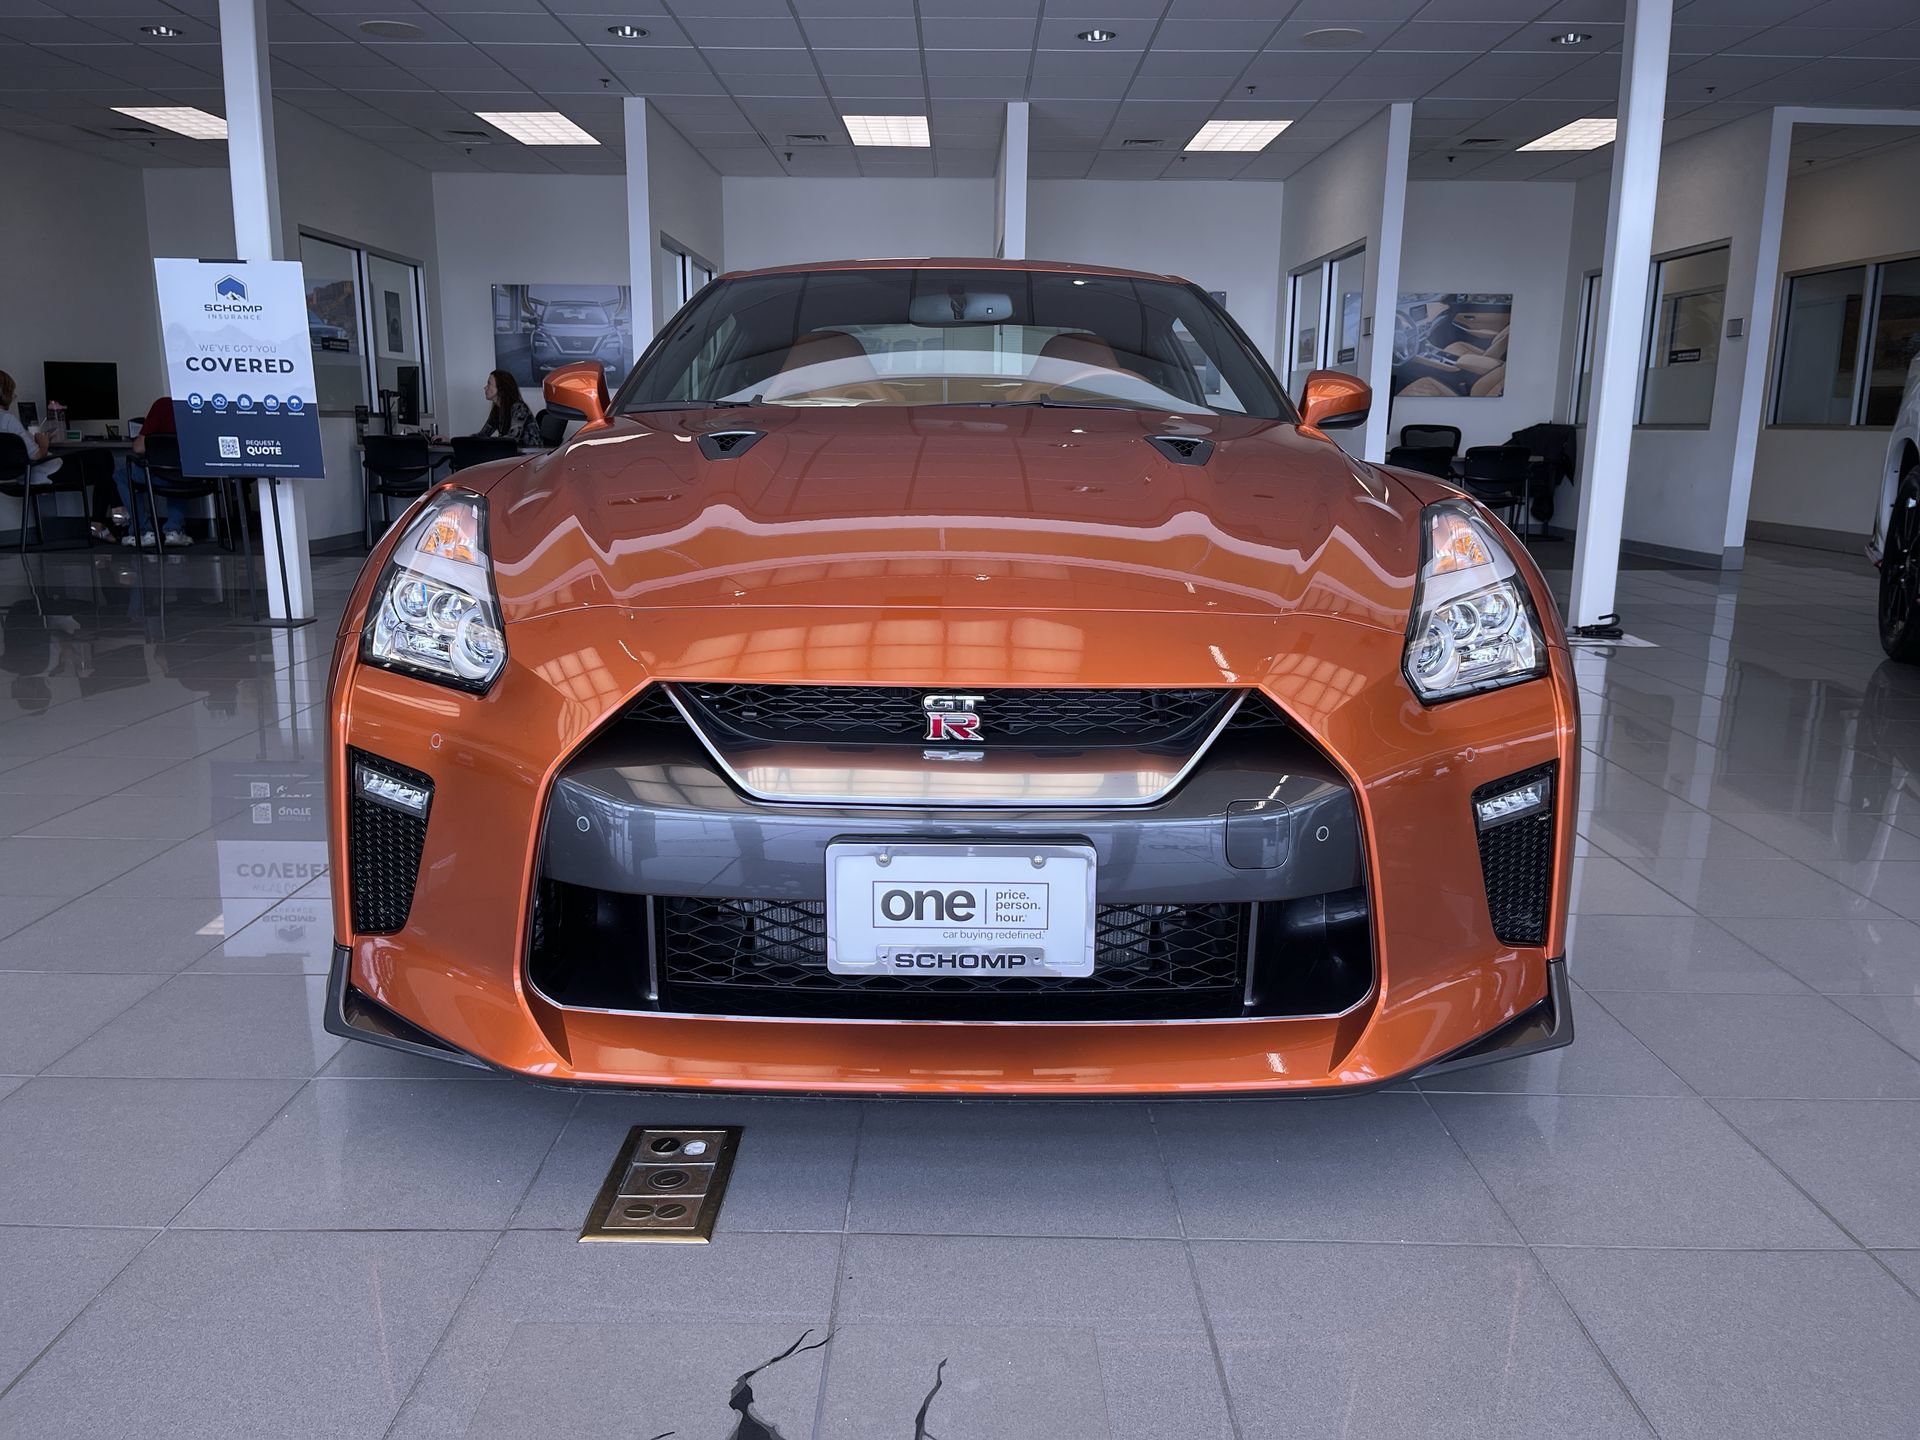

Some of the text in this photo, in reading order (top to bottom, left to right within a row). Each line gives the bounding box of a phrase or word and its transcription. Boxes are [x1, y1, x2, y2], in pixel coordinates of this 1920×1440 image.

[204, 303, 263, 313] SCHOMP
[207, 313, 261, 321] INSURANCE
[199, 344, 277, 353] WE'VE GOT YOU
[185, 356, 295, 374] COVERED
[245, 439, 275, 447] REQUEST
[246, 446, 282, 456] QUOTE
[995, 889, 1030, 902] price.
[880, 888, 976, 922] one
[995, 901, 1041, 912] person.
[942, 931, 958, 939] car
[960, 930, 993, 941] buying
[895, 953, 1026, 969] SCHOMP
